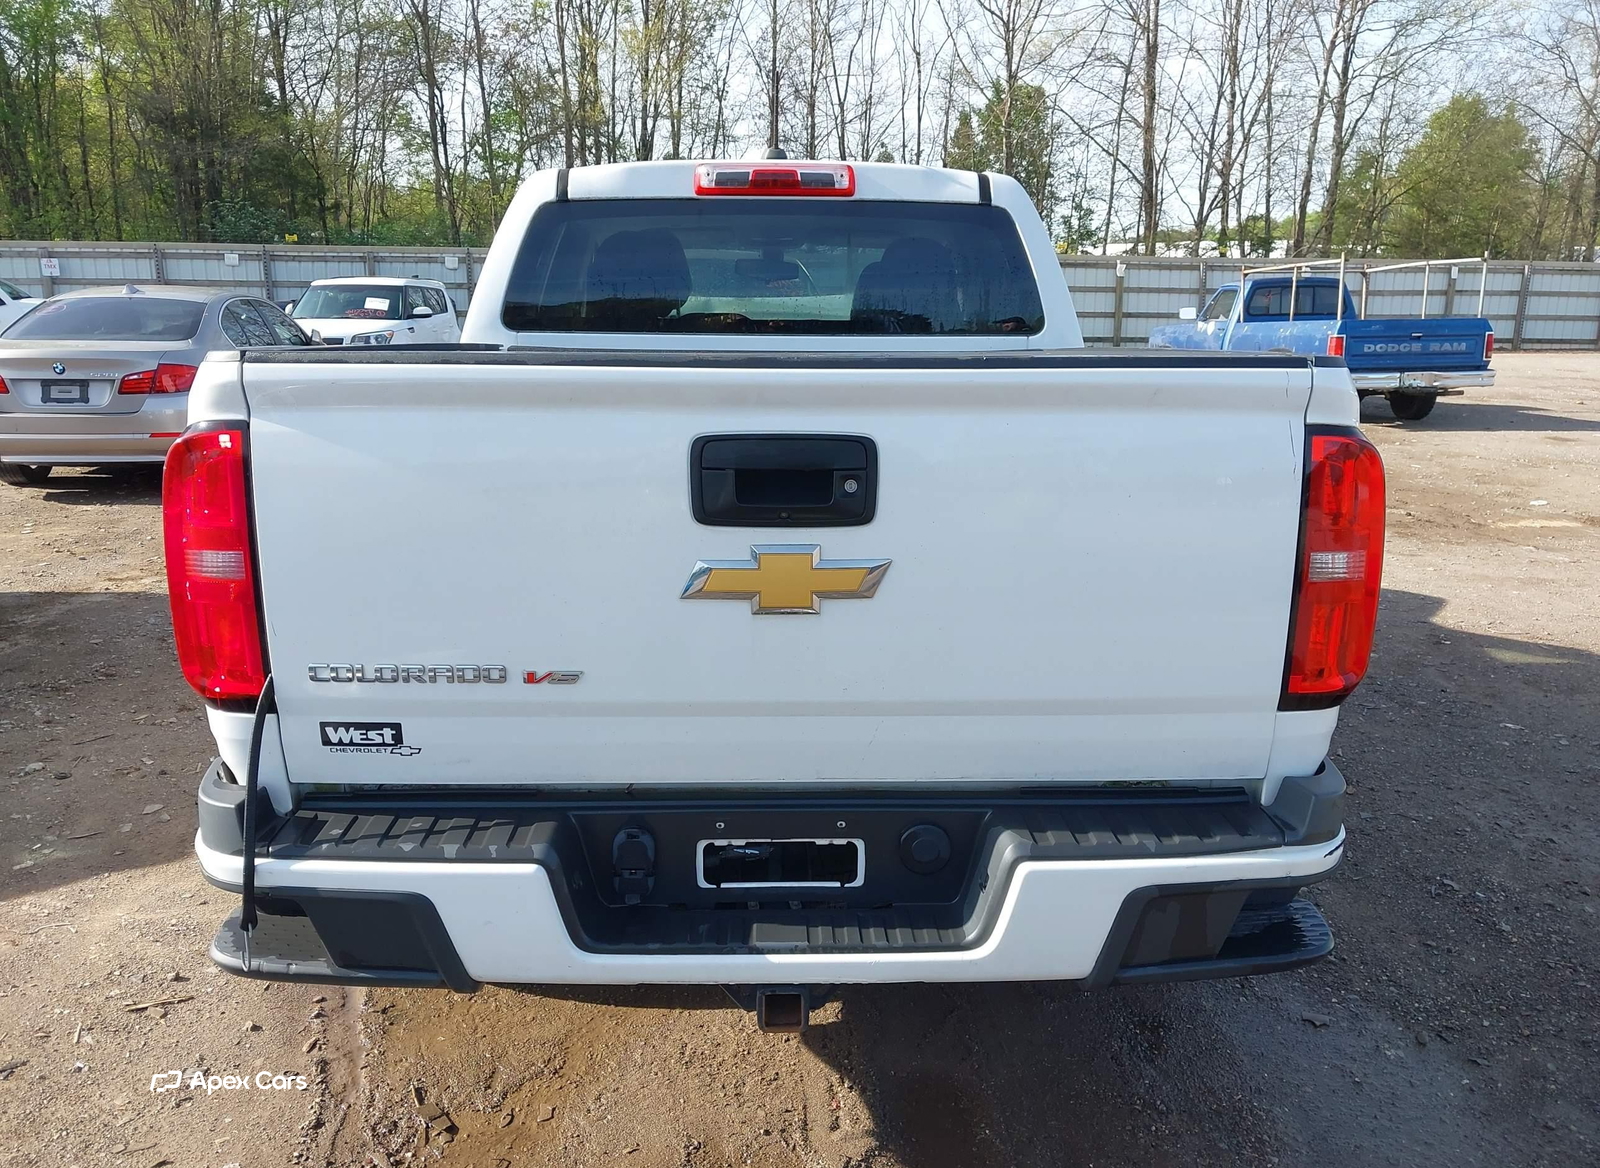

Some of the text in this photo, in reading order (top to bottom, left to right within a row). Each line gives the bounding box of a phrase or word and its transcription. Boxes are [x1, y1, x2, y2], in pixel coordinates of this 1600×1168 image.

[1363, 342, 1466, 352] DODGE RAM
[307, 663, 585, 685] COLORADO V6
